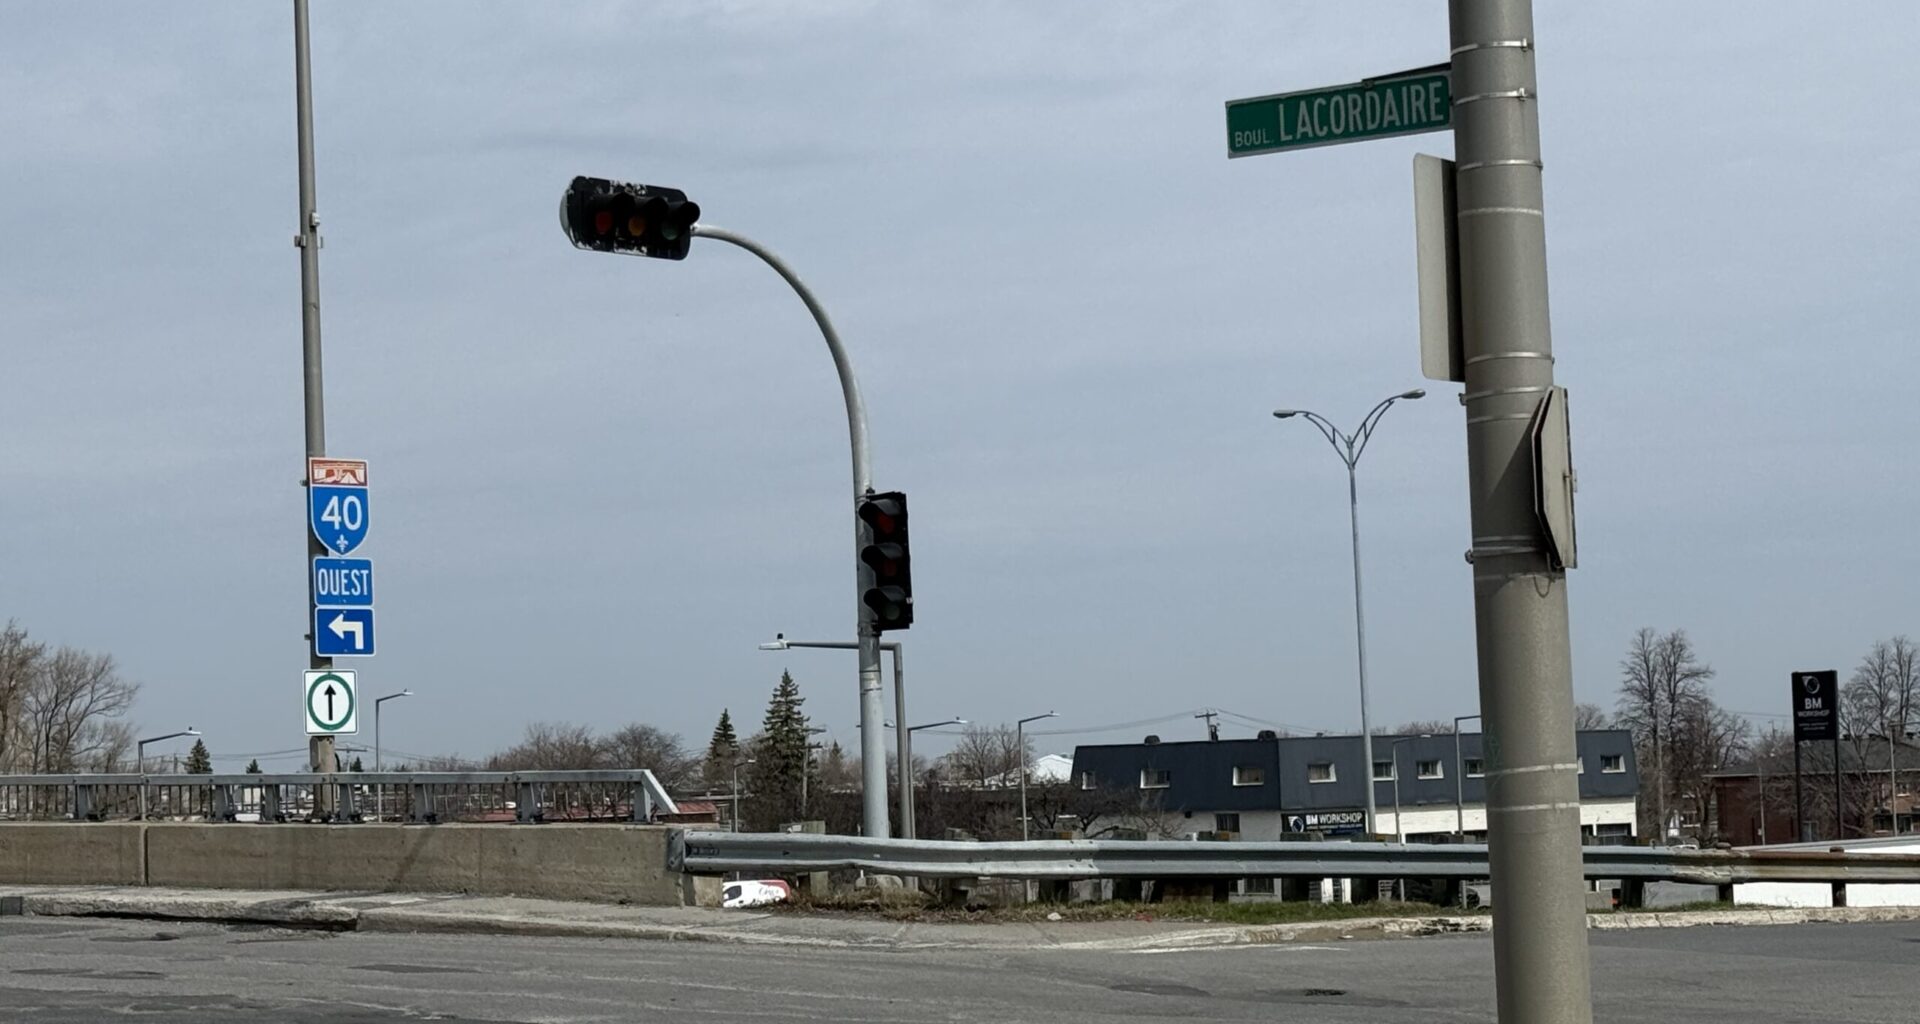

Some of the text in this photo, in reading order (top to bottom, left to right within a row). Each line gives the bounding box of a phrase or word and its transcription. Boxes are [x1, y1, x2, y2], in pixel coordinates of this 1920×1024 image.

[1278, 81, 1444, 142] LACORDAIRE
[321, 495, 363, 531] 40
[318, 568, 369, 596] OUEST
[1804, 697, 1822, 710] BM
[1305, 812, 1363, 825] BM WORKSHOP
